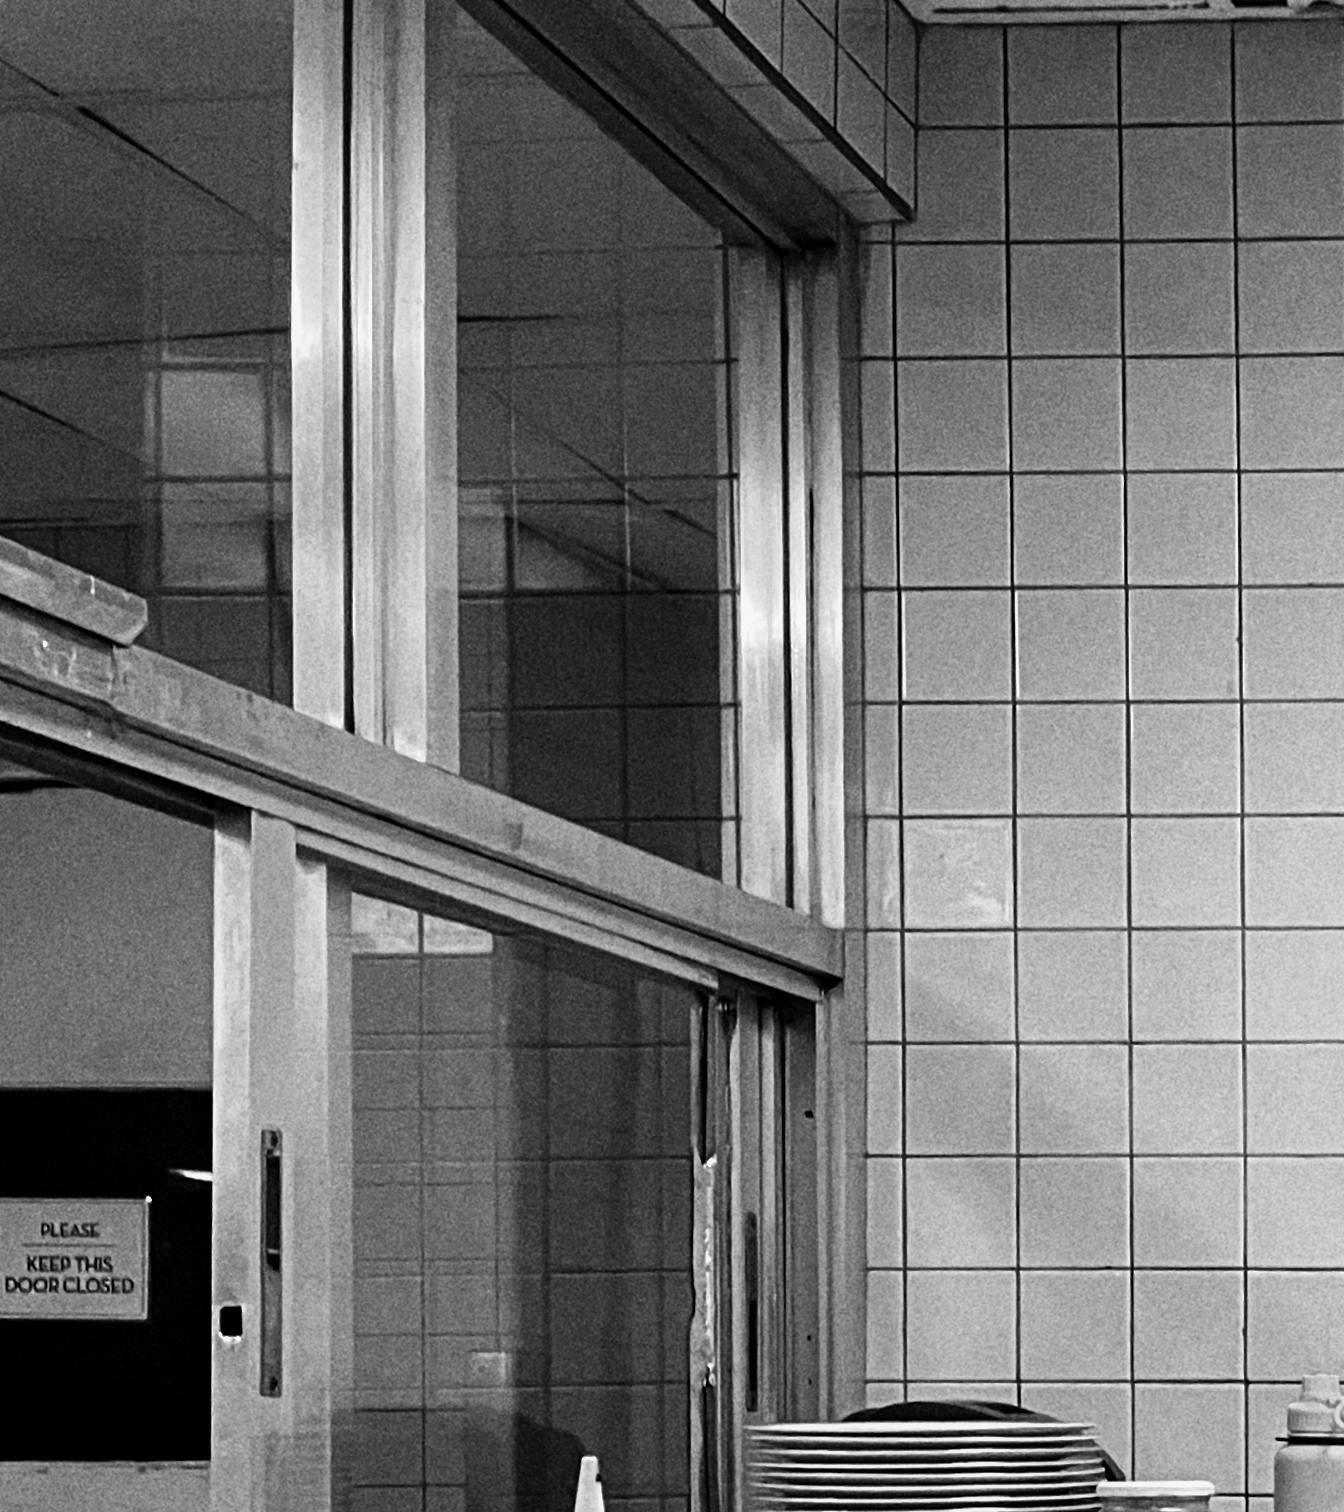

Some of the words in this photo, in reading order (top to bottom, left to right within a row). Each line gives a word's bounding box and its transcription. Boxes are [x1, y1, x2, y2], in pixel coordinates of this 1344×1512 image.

[41, 1223, 100, 1238] PLEASE
[27, 1256, 71, 1272] KEEP
[75, 1256, 113, 1273] THIS
[5, 1277, 60, 1294] DOOR
[63, 1277, 135, 1295] CLOSED
